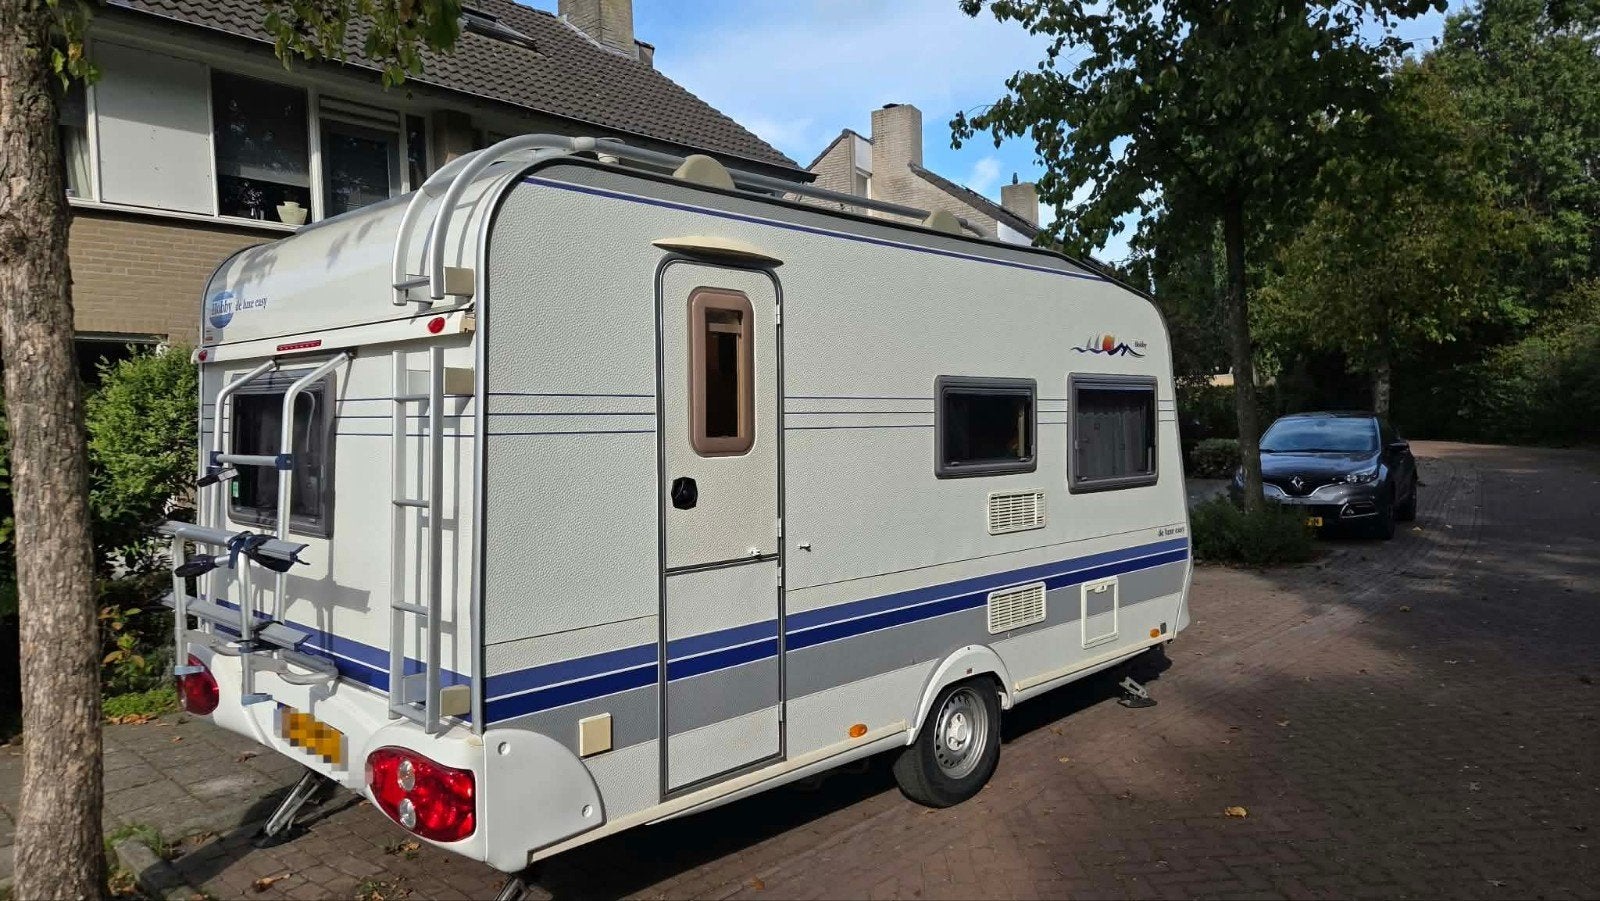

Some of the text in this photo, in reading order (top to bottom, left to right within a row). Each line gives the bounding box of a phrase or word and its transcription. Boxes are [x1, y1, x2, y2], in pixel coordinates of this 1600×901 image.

[211, 300, 232, 316] Hobby
[235, 297, 268, 311] de luxe easy
